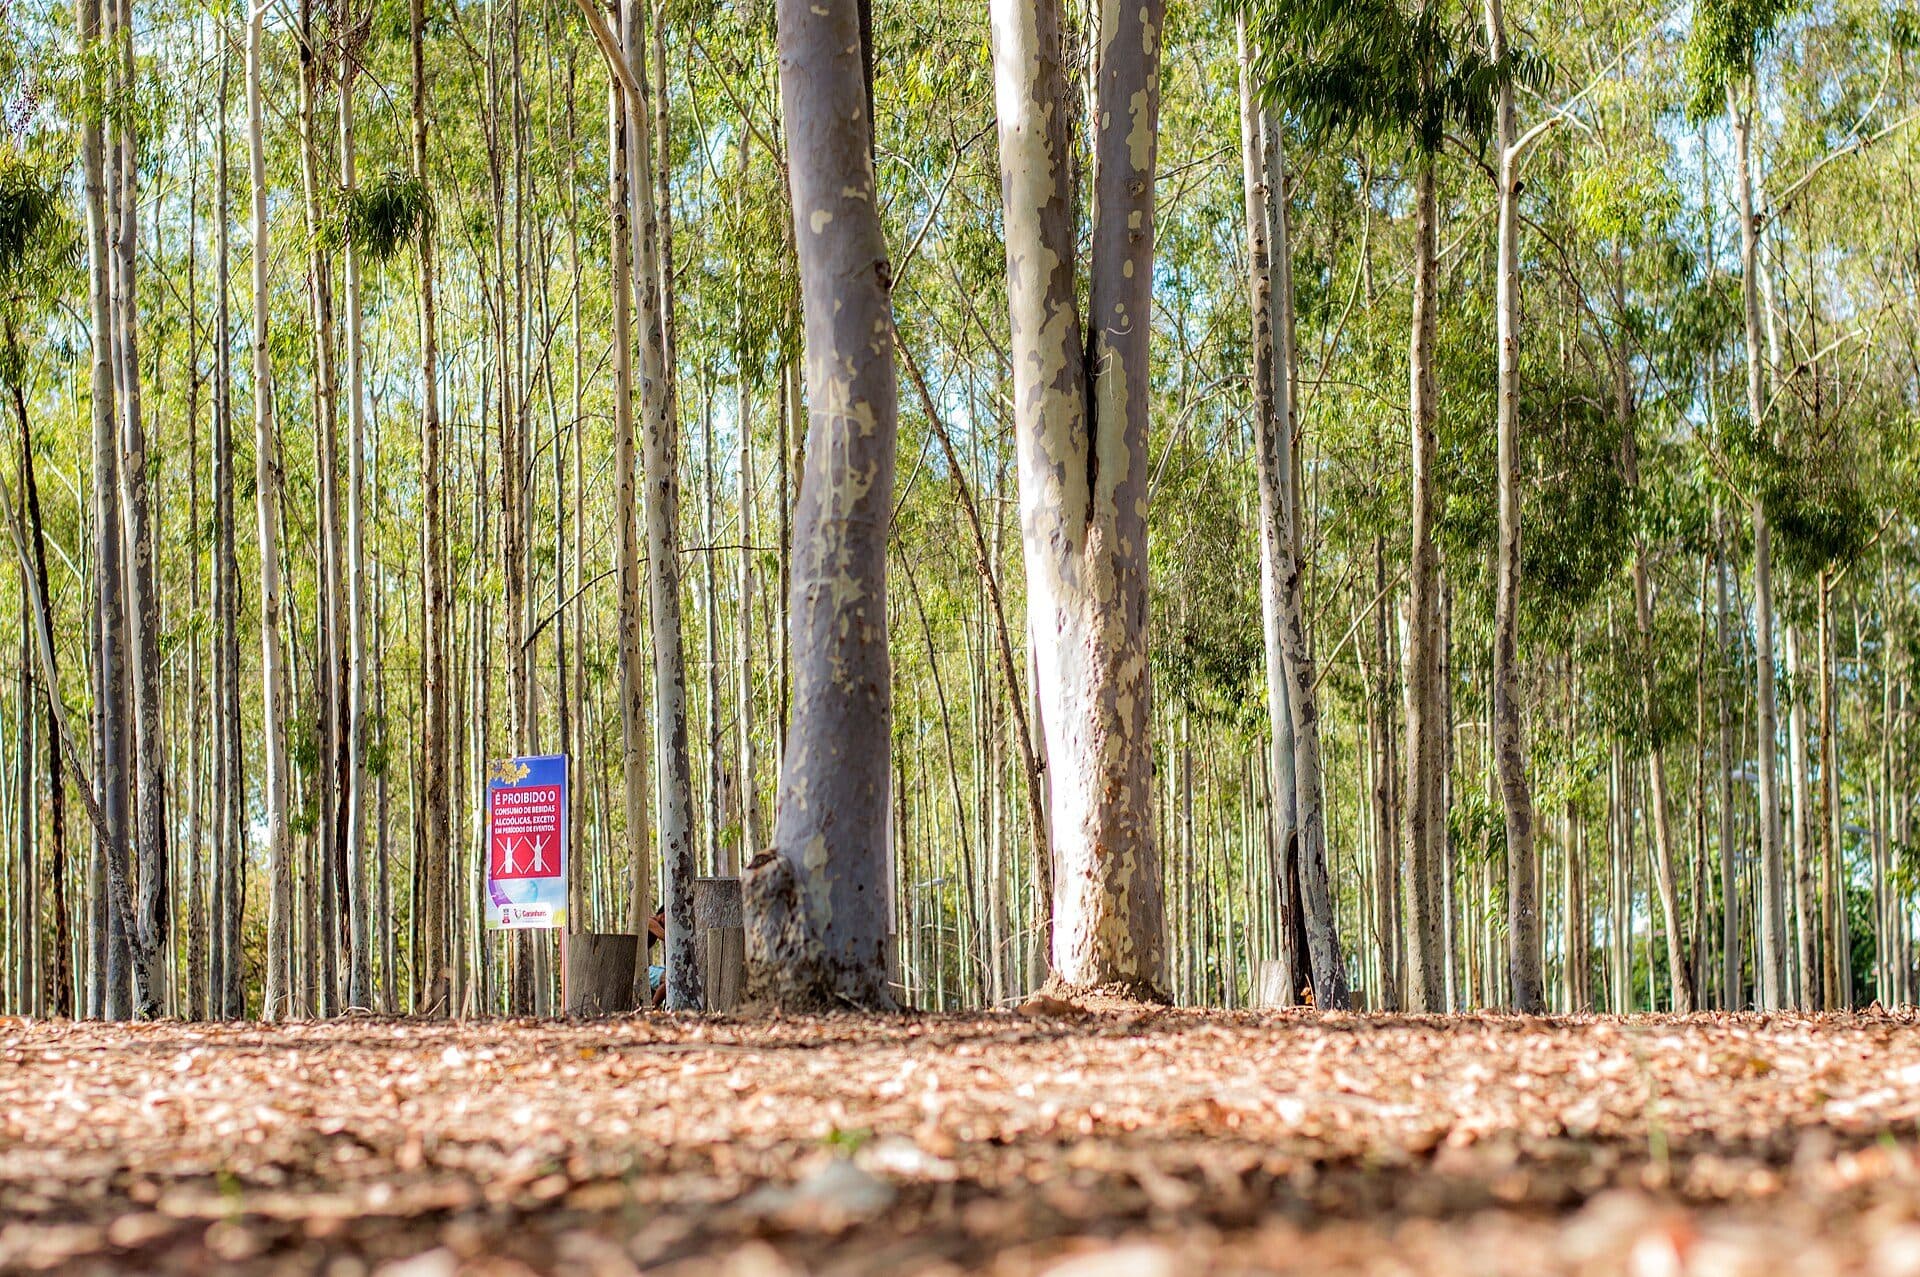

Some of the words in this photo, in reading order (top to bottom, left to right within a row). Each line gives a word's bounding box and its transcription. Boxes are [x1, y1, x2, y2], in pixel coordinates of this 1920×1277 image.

[496, 792, 500, 805] É
[503, 791, 546, 804] PROIBIDO
[548, 790, 556, 802] O
[495, 807, 523, 816] CONSUMO
[532, 805, 555, 814] BEBIDAS
[495, 816, 532, 826] ALCOÓLICAS,
[532, 815, 555, 824] EXCETO
